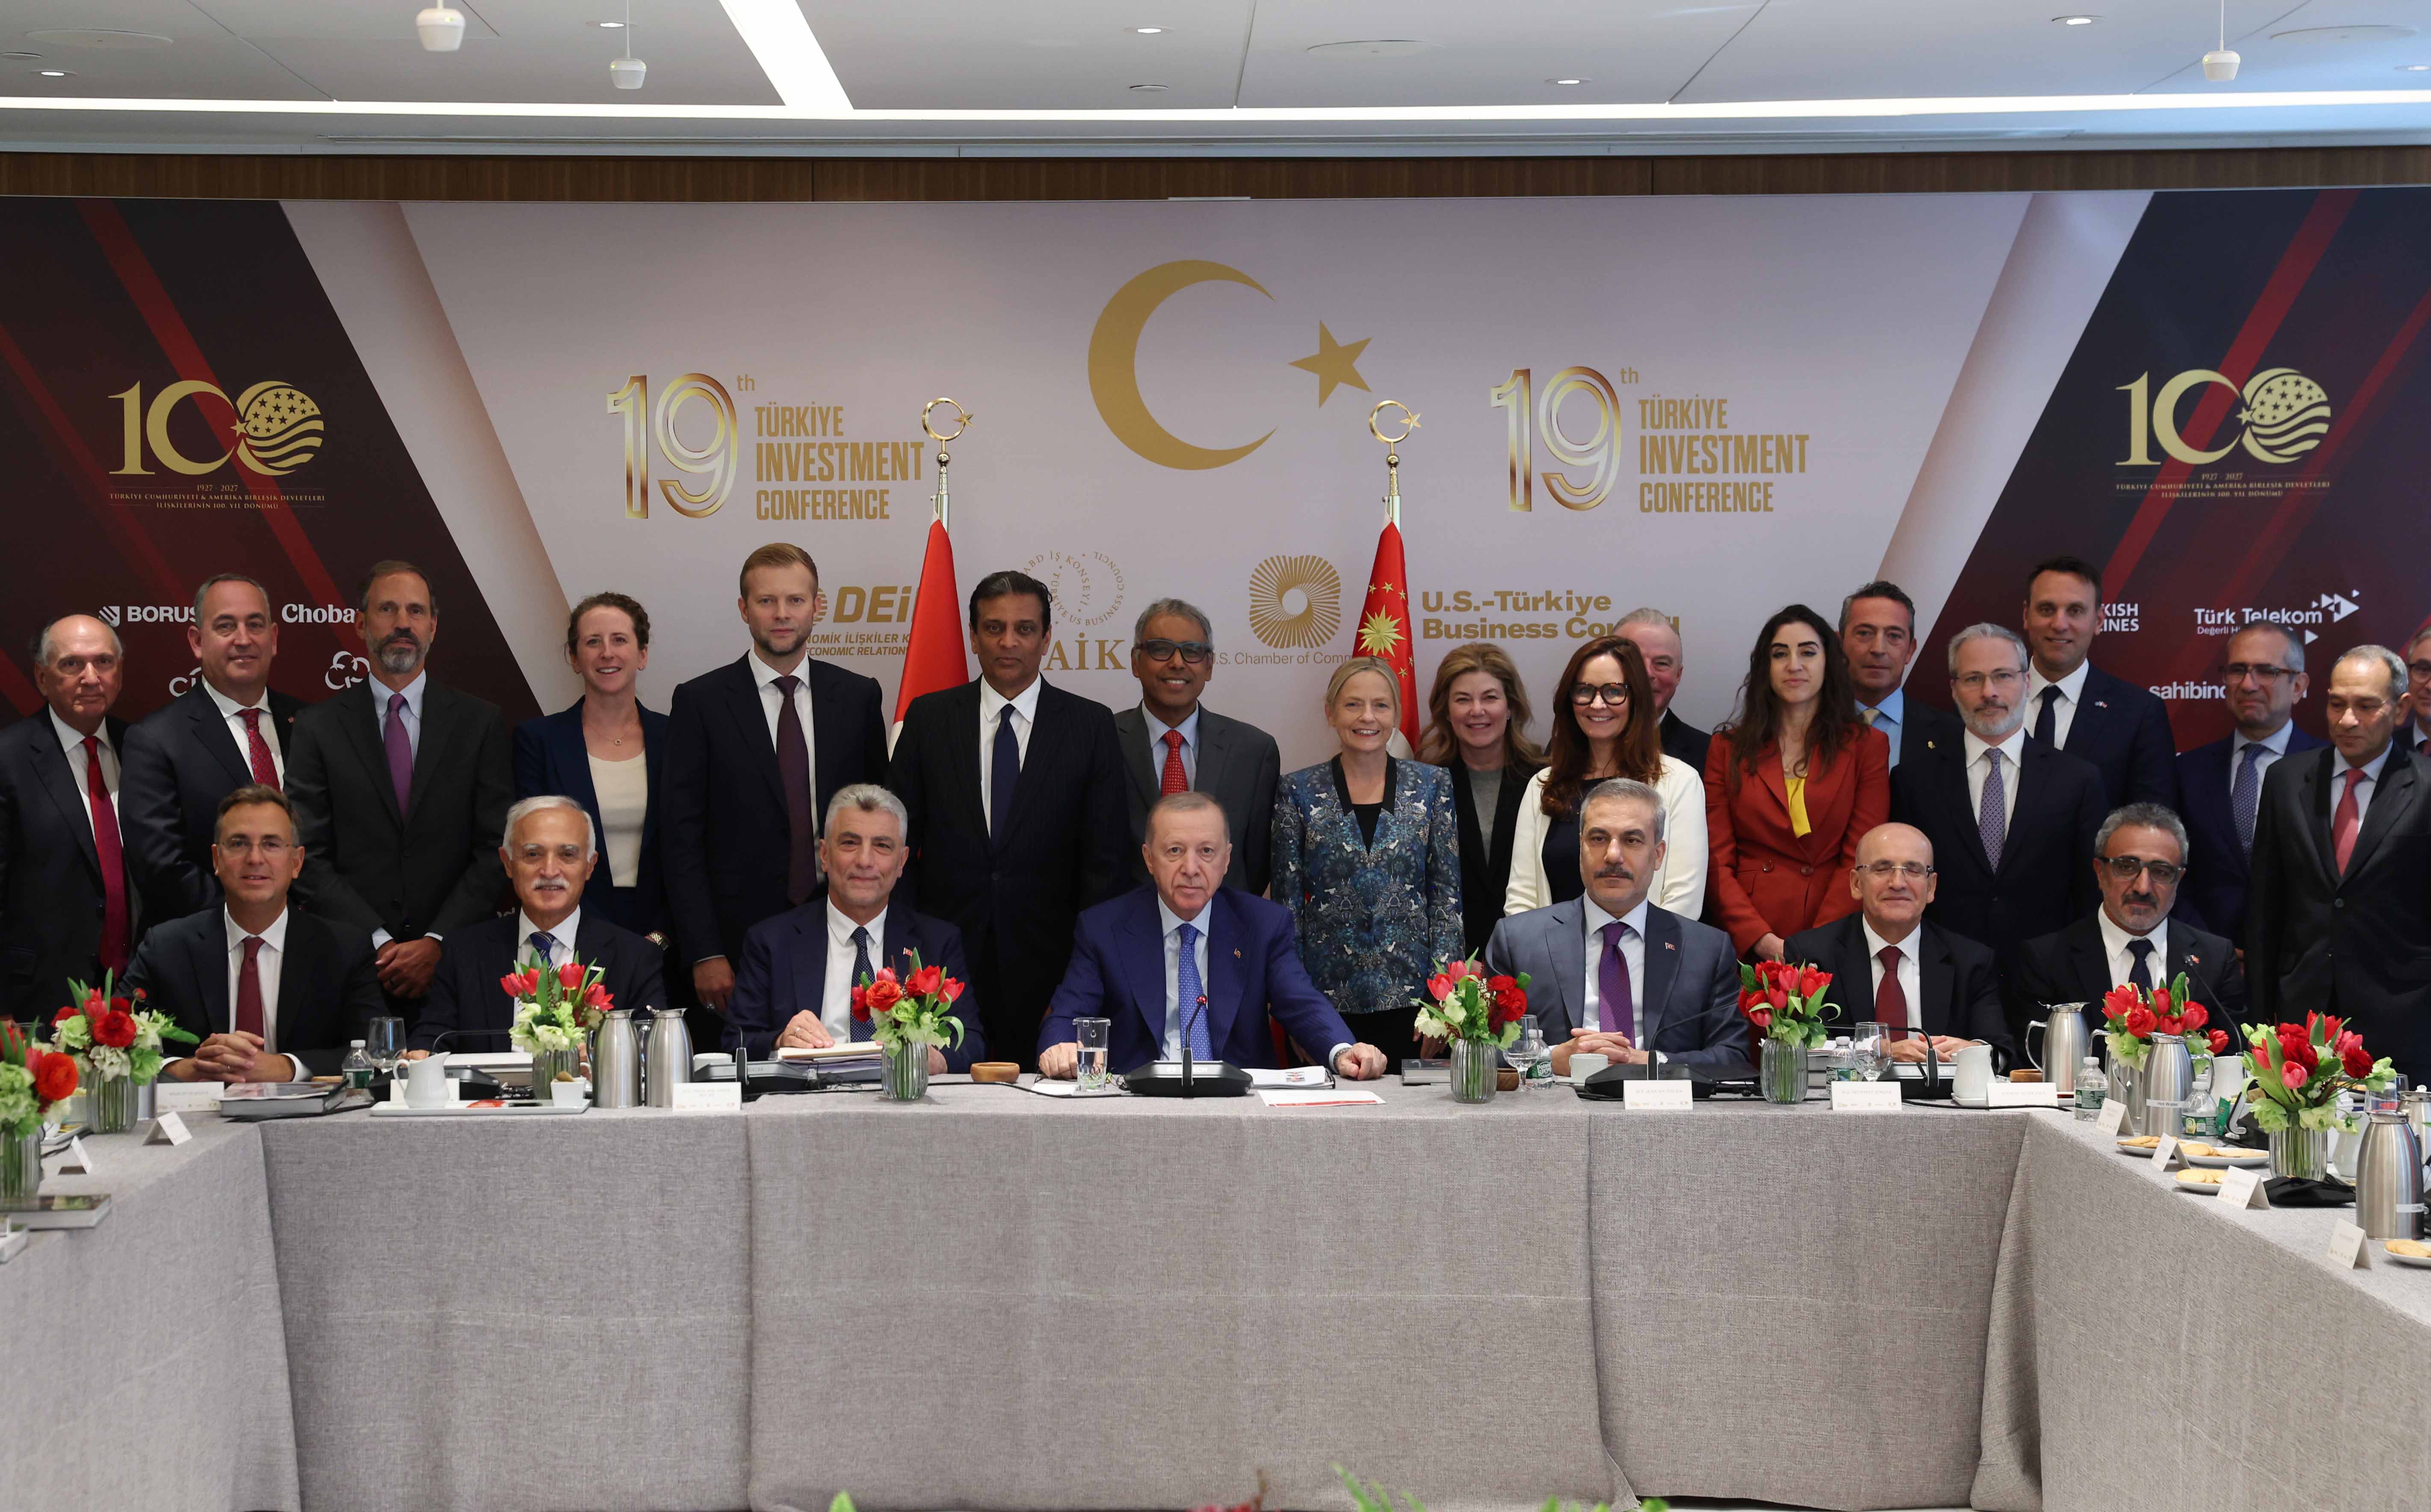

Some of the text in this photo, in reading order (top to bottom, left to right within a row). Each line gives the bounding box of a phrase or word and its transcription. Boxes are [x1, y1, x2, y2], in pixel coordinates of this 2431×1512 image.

[754, 401, 844, 437] TÜRKİYE
[1638, 394, 1728, 429] TÜRKİYE
[756, 441, 924, 482] INVESTMENT
[1639, 434, 1810, 475] INVESTMENT
[756, 489, 890, 520] CONFERENCE
[1639, 482, 1774, 513] CONFERENCE
[1023, 554, 1044, 575] ABD
[1094, 551, 1125, 591] COUNCIL
[281, 603, 357, 623] Choba
[1085, 594, 1124, 626] BUSINESS
[1423, 590, 1611, 616] U.S.-Türkiye
[2194, 608, 2322, 624] Türk Telekom
[1070, 614, 1082, 625] US
[1423, 617, 1558, 640] Business
[2197, 626, 2229, 636] Değerli
[845, 631, 899, 646] İLİŞKİLER
[857, 646, 908, 656] RELATION
[1043, 632, 1127, 670] AİK
[1235, 652, 1293, 664] Chamber
[1297, 652, 1310, 664] of
